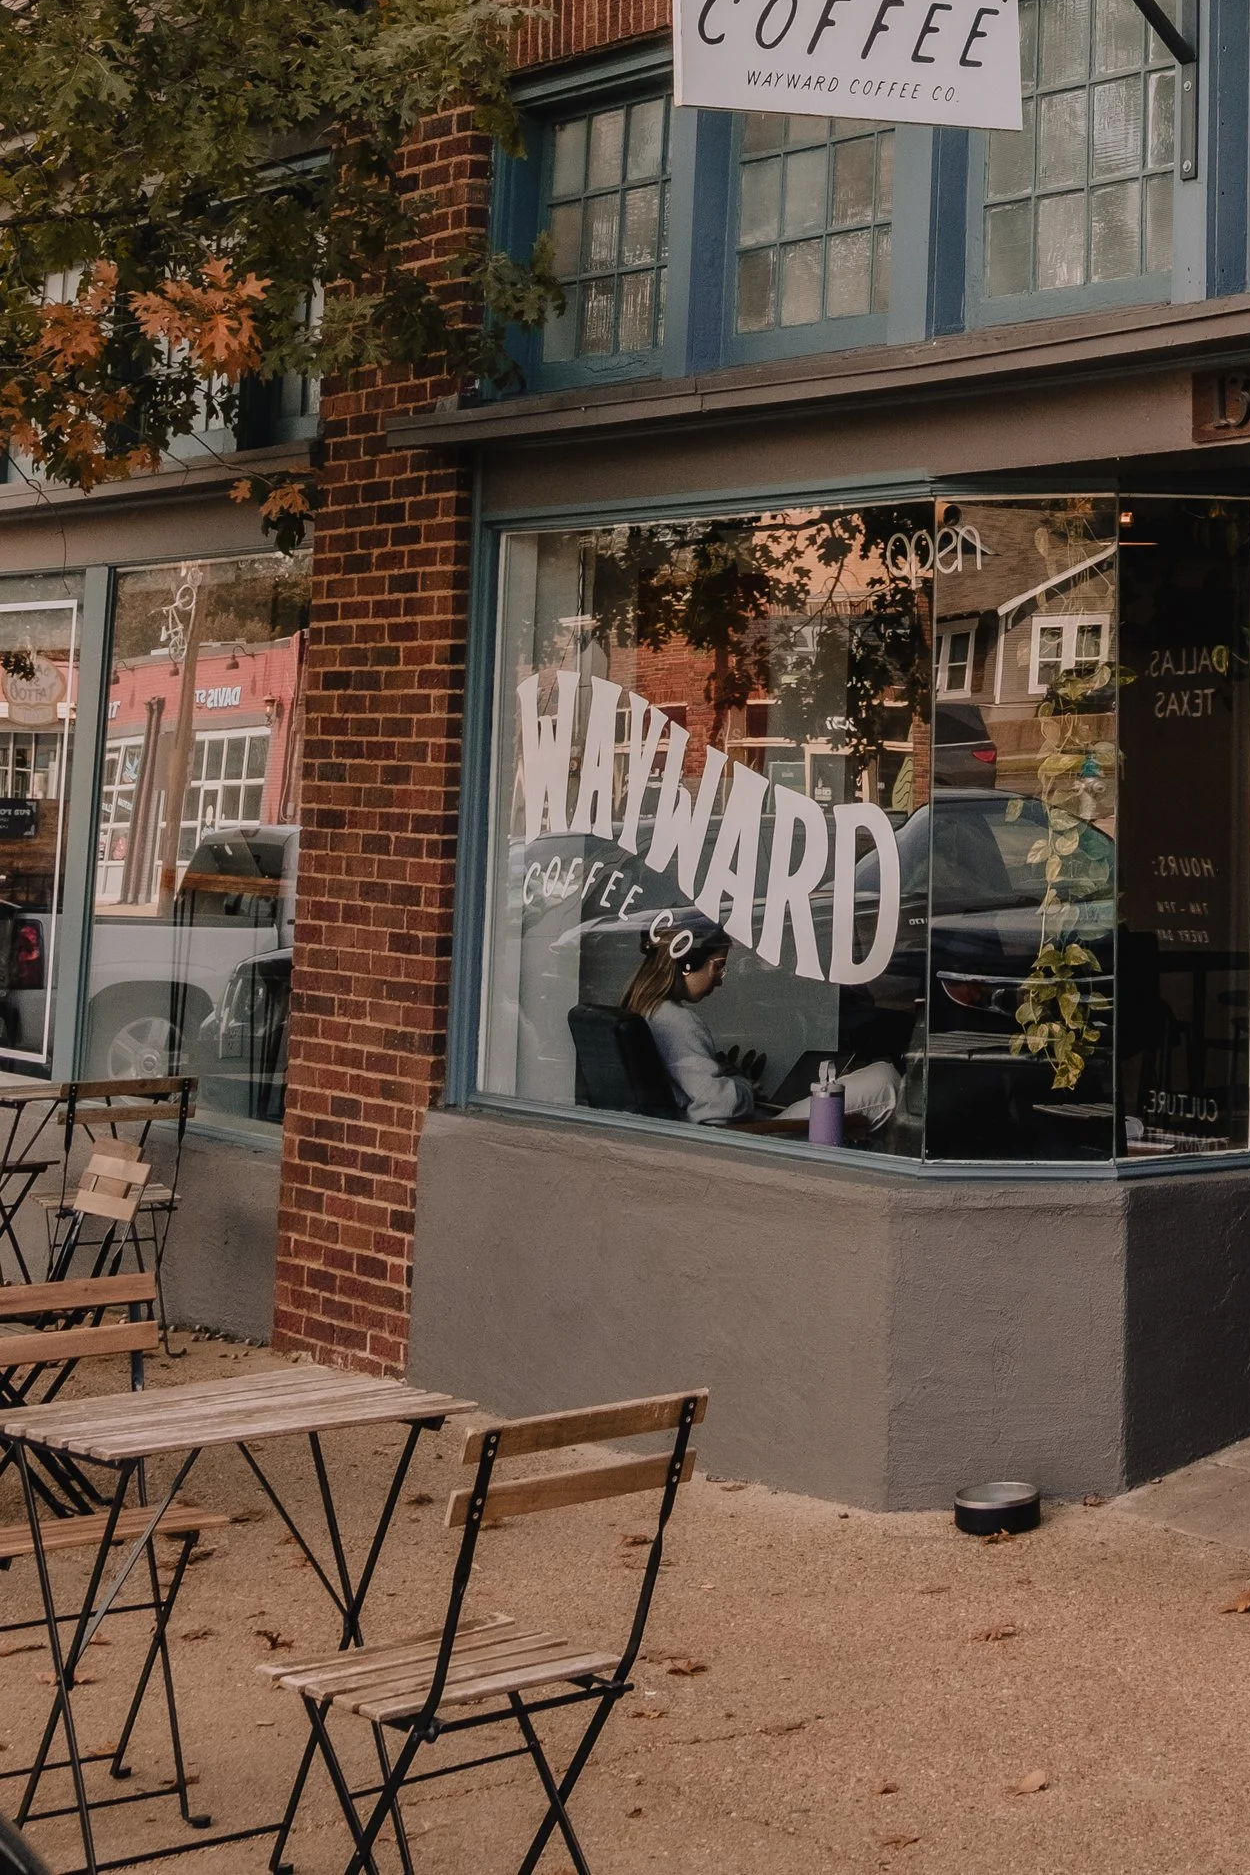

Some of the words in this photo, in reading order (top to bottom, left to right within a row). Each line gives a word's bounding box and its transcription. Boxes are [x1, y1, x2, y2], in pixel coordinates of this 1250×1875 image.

[746, 70, 839, 93] WAYWARD
[849, 79, 923, 100] COFFEE
[931, 85, 960, 103] CO.
[885, 525, 982, 590] open
[516, 670, 900, 985] WAYWARD
[522, 856, 643, 921] COFFEE
